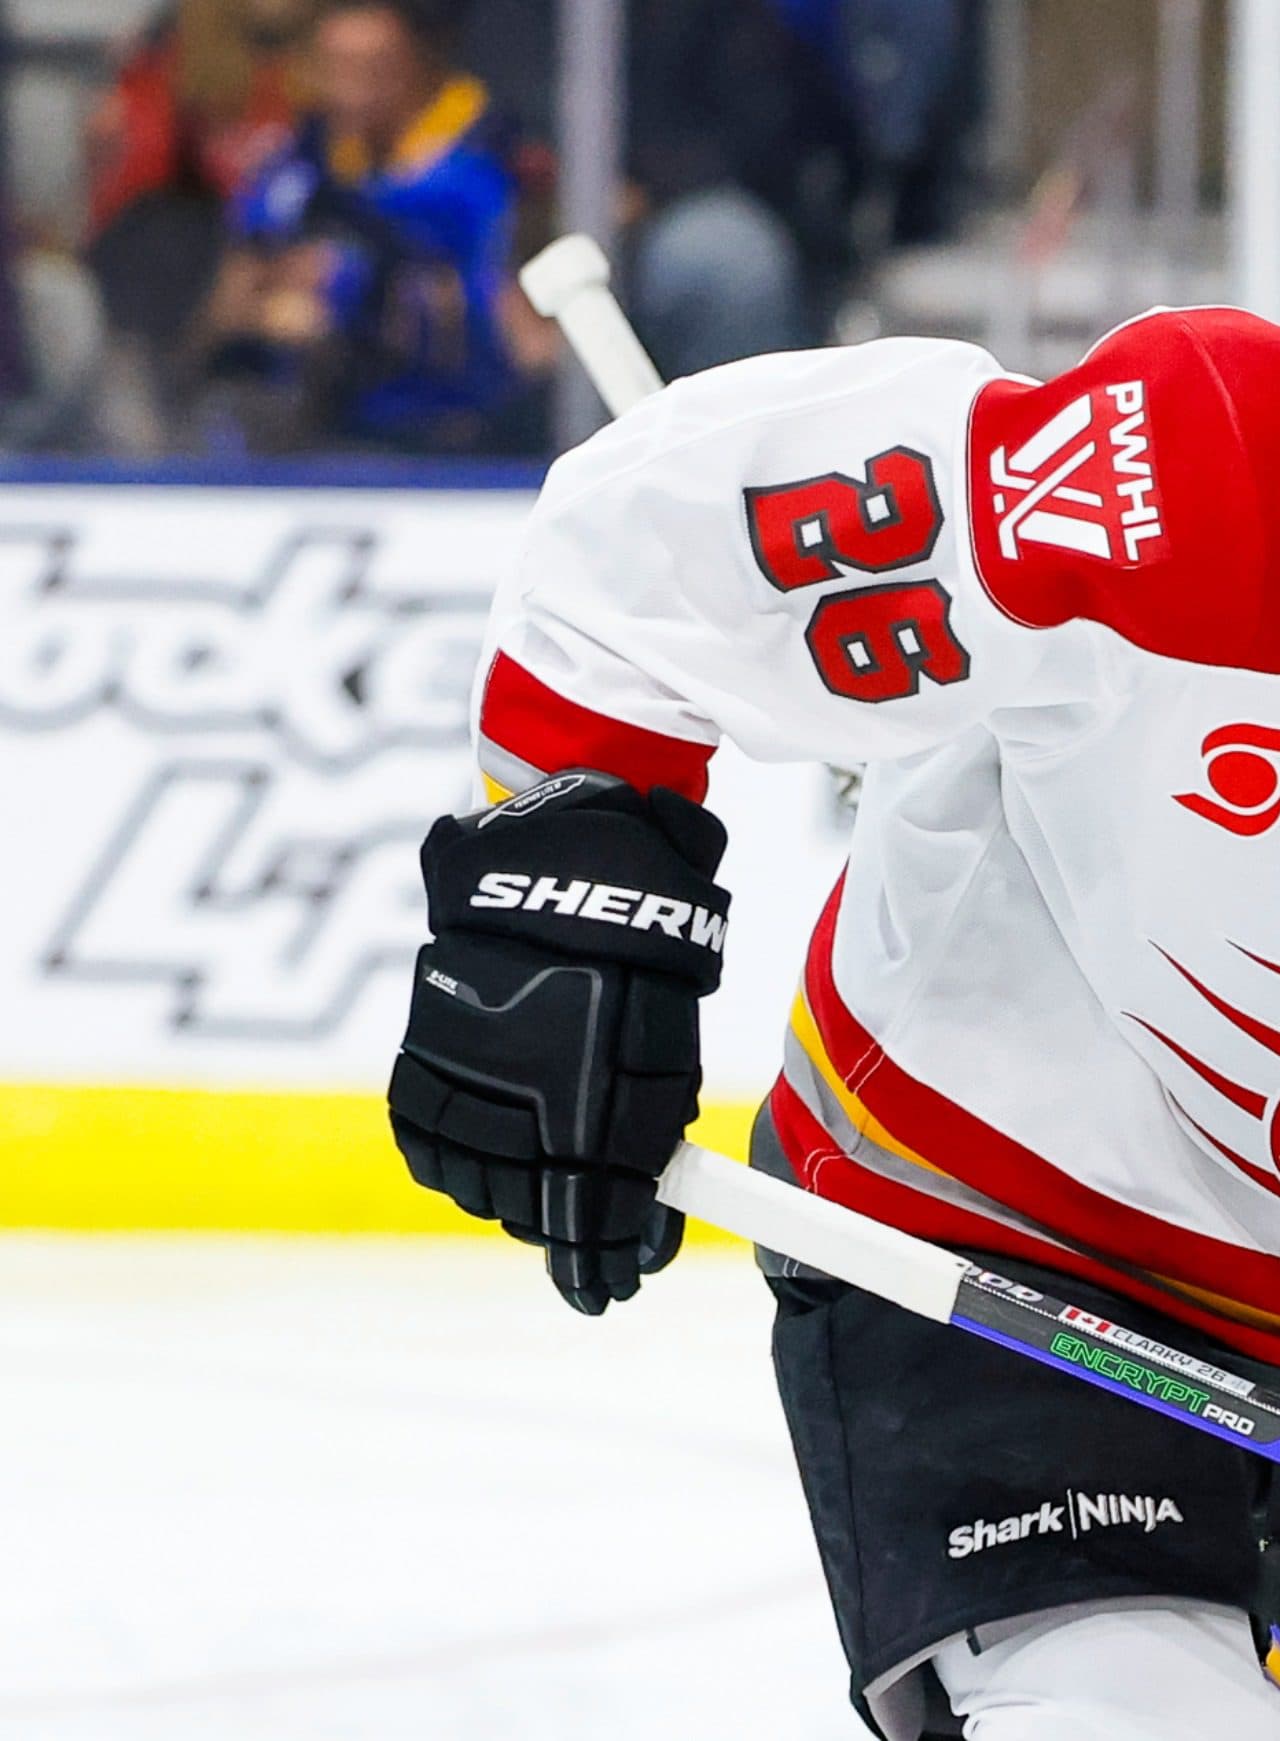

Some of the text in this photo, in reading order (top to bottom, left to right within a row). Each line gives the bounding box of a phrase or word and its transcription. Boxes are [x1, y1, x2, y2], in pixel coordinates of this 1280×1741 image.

[1104, 379, 1164, 562] PWHL
[743, 445, 971, 703] 26
[470, 872, 729, 954] SHERW
[1050, 1332, 1255, 1436] ENCRYPT PRO
[1112, 1328, 1226, 1383] CLARKY 26
[947, 1491, 1184, 1558] Shark NINJA
